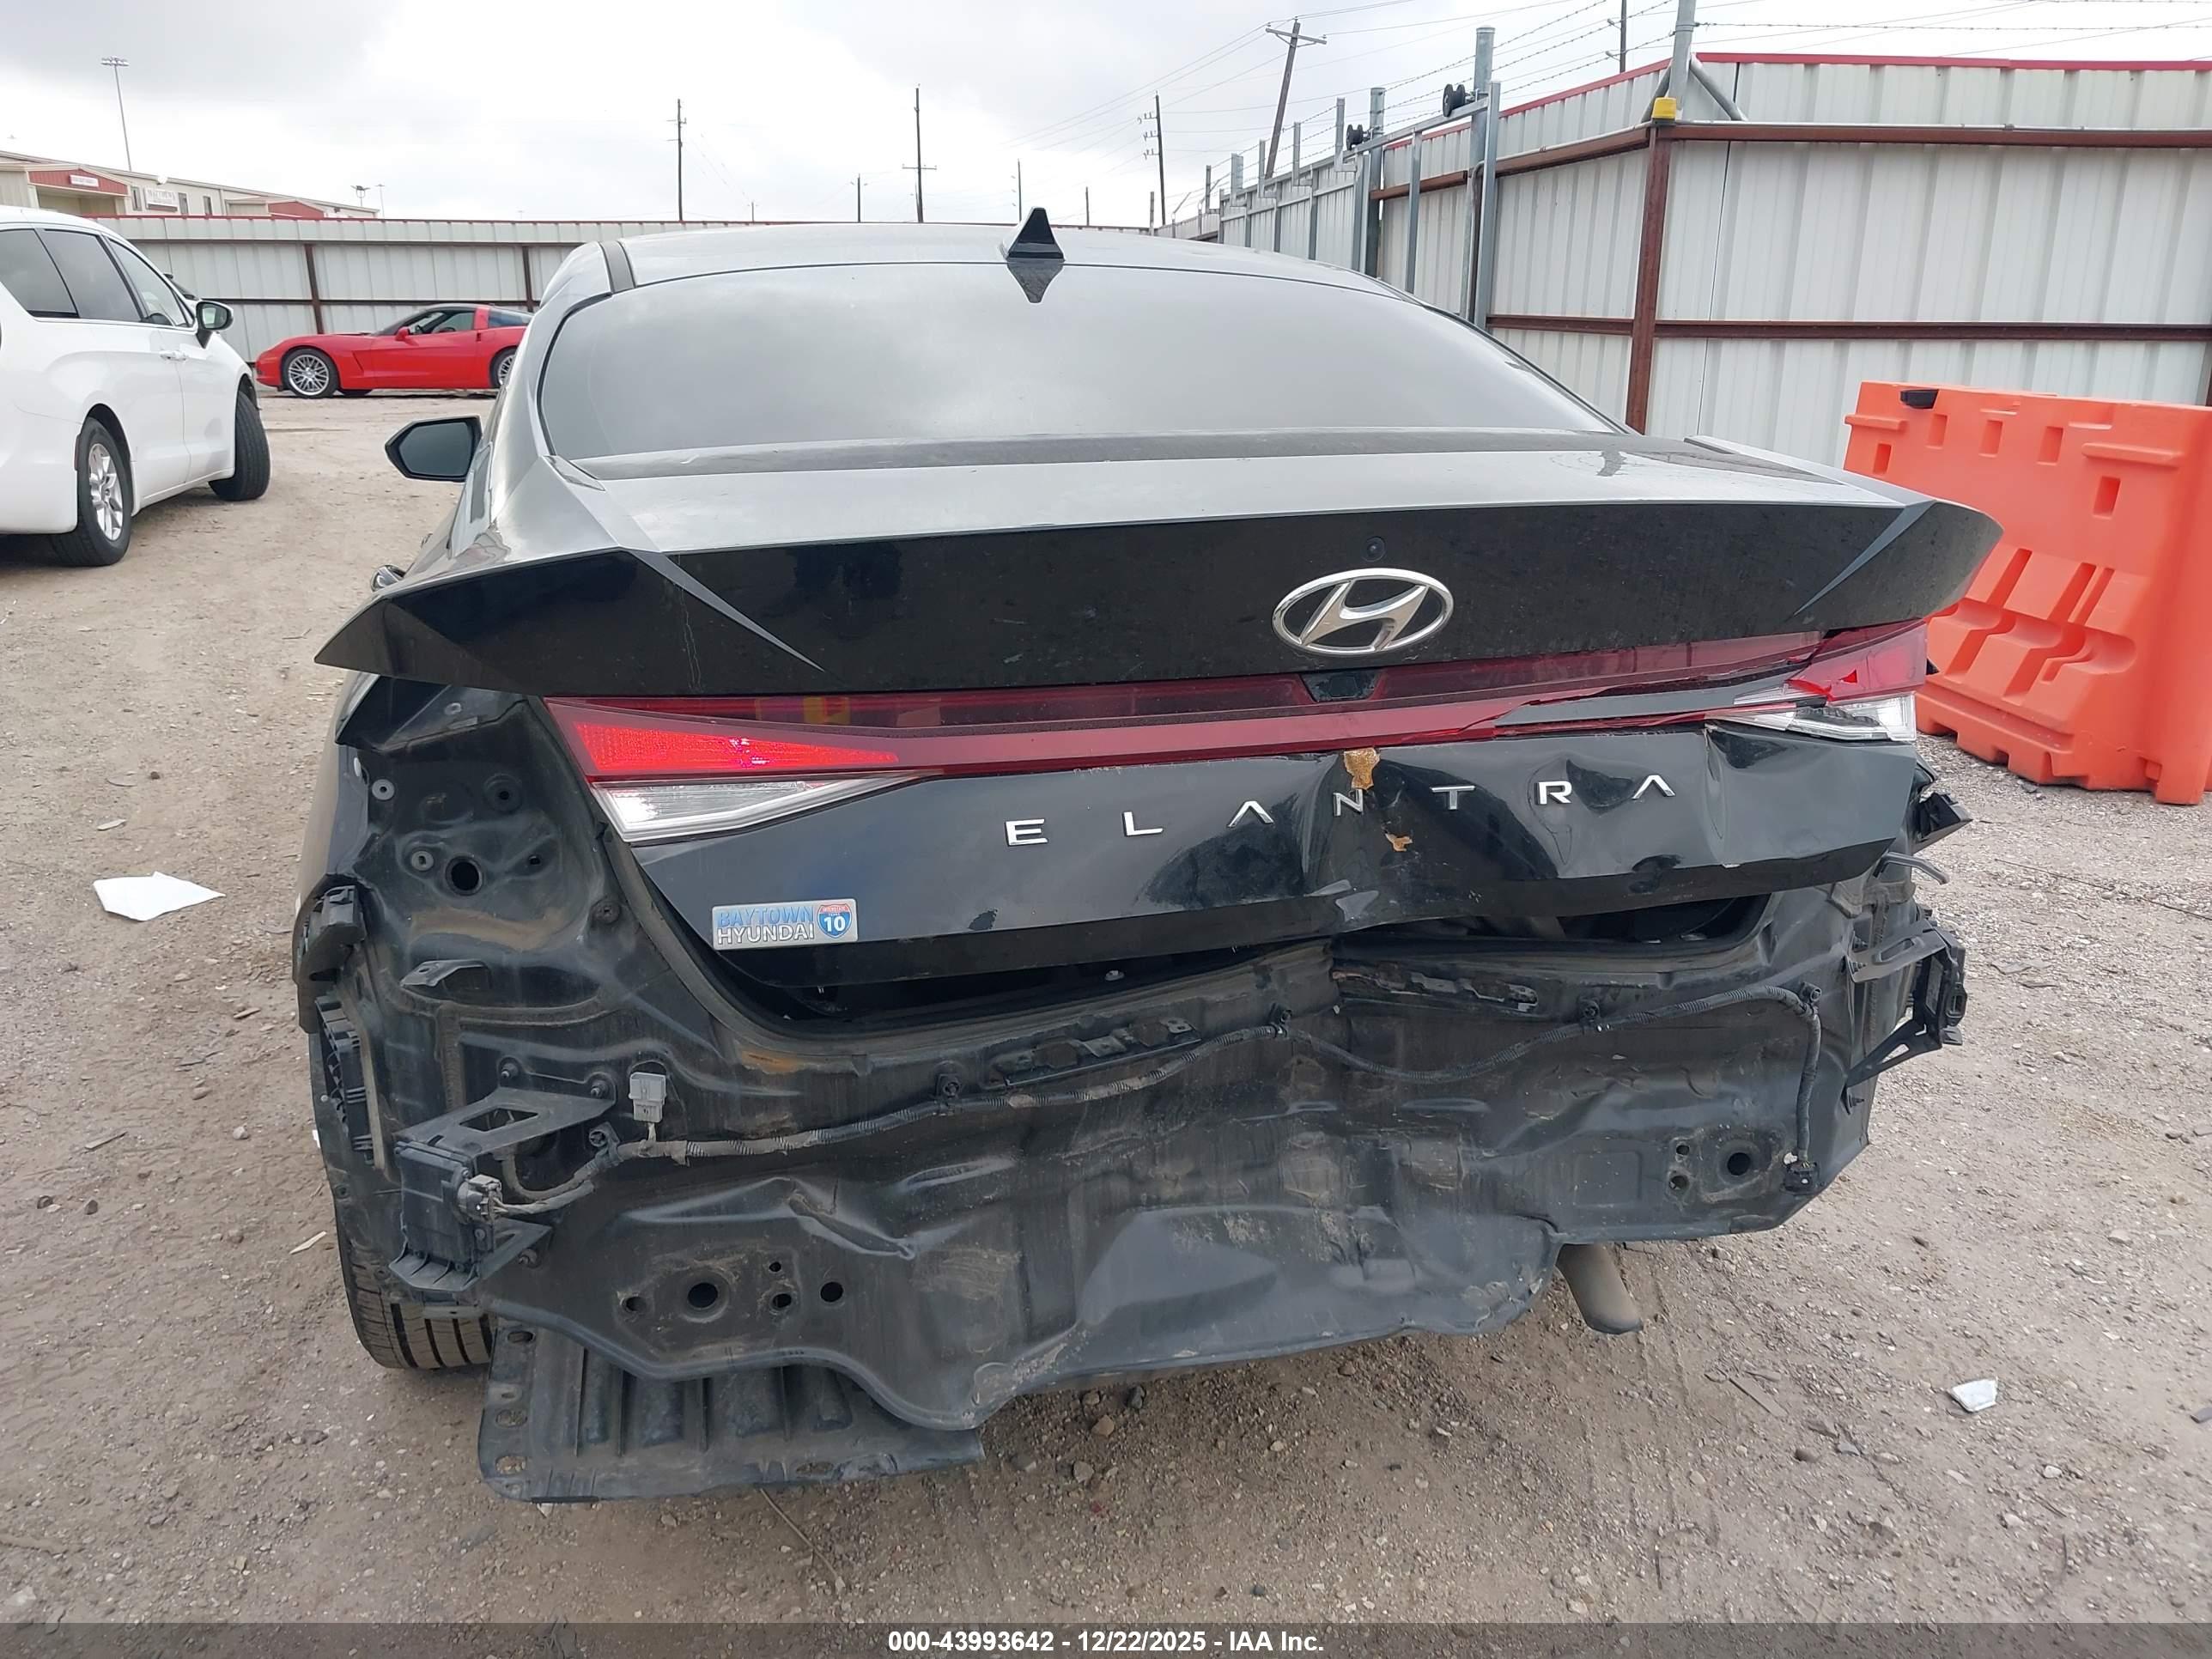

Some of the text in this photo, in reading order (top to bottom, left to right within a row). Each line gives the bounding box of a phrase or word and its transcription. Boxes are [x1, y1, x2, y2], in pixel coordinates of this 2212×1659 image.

[1005, 774, 1676, 847] ELANTRA
[718, 906, 814, 927] BAYTOWN
[823, 915, 846, 933] 10
[717, 923, 815, 945] HYUNDAI
